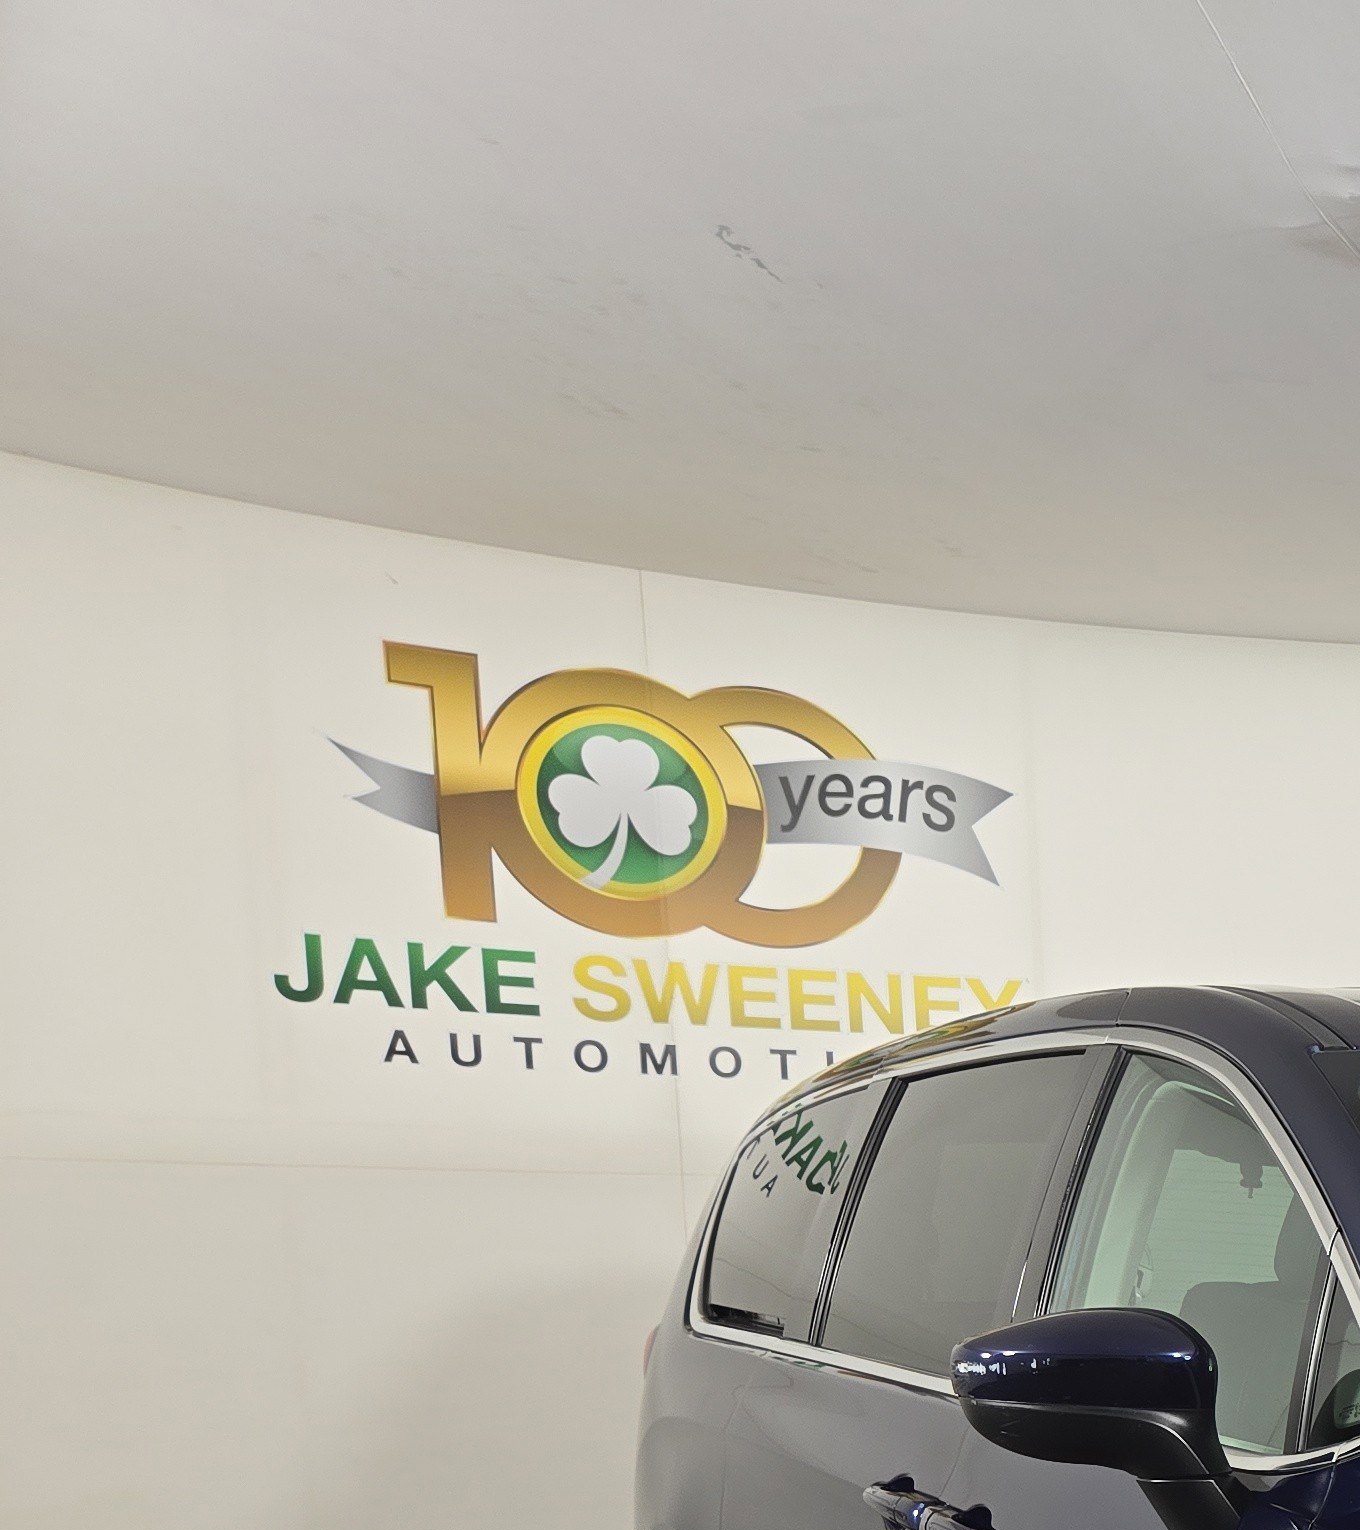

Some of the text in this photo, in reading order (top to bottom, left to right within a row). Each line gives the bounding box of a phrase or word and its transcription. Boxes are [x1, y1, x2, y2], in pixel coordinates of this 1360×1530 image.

[383, 640, 903, 948] 100
[777, 769, 957, 833] years
[274, 933, 541, 1016] JAKE
[384, 1029, 834, 1082] AUTOMOT
